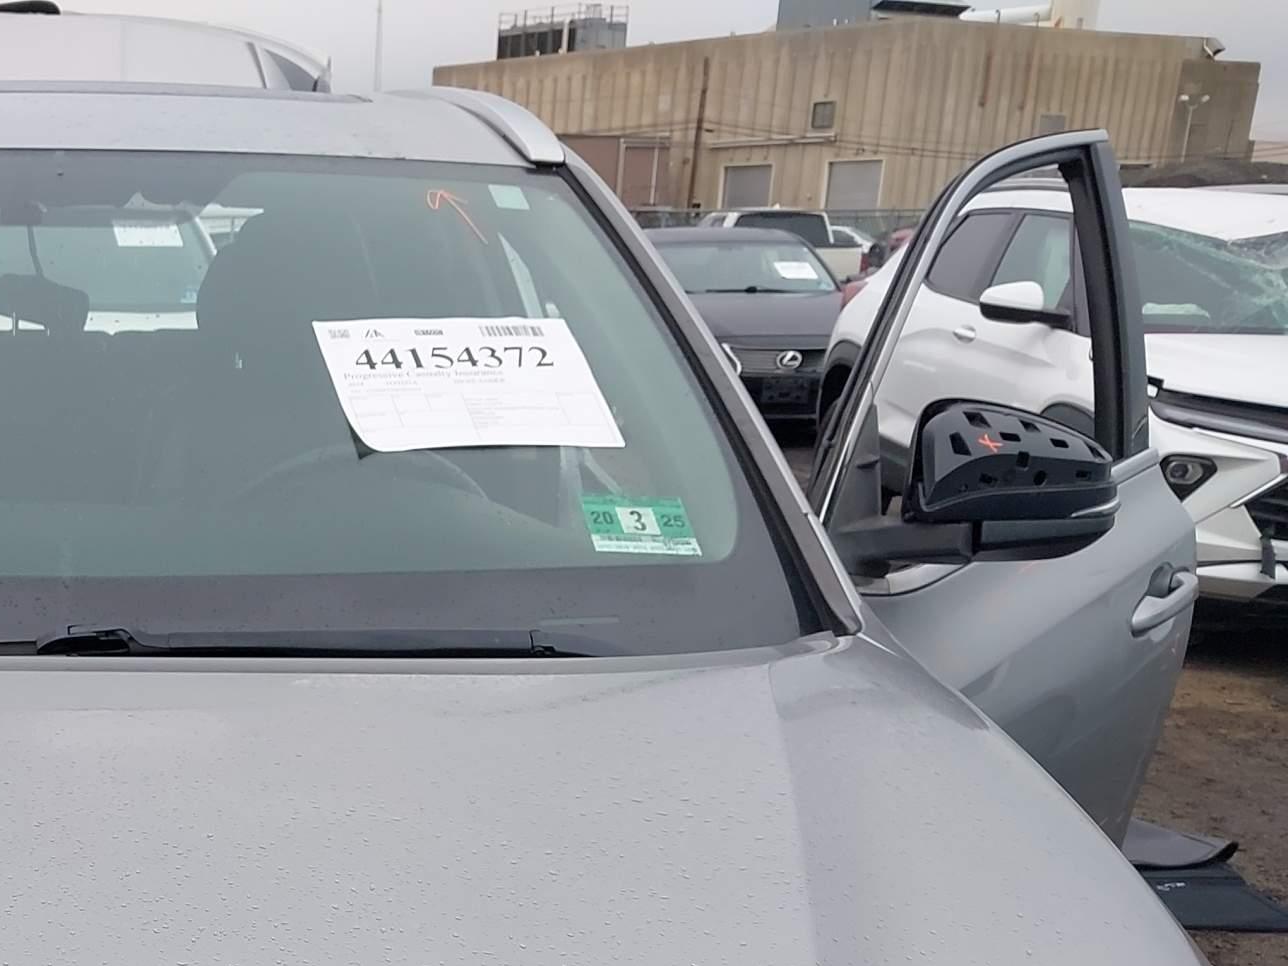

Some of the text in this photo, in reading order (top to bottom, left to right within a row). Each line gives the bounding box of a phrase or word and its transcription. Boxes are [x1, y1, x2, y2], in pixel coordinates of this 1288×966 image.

[355, 346, 555, 370] 44154372
[590, 510, 686, 531] 20 3 25
